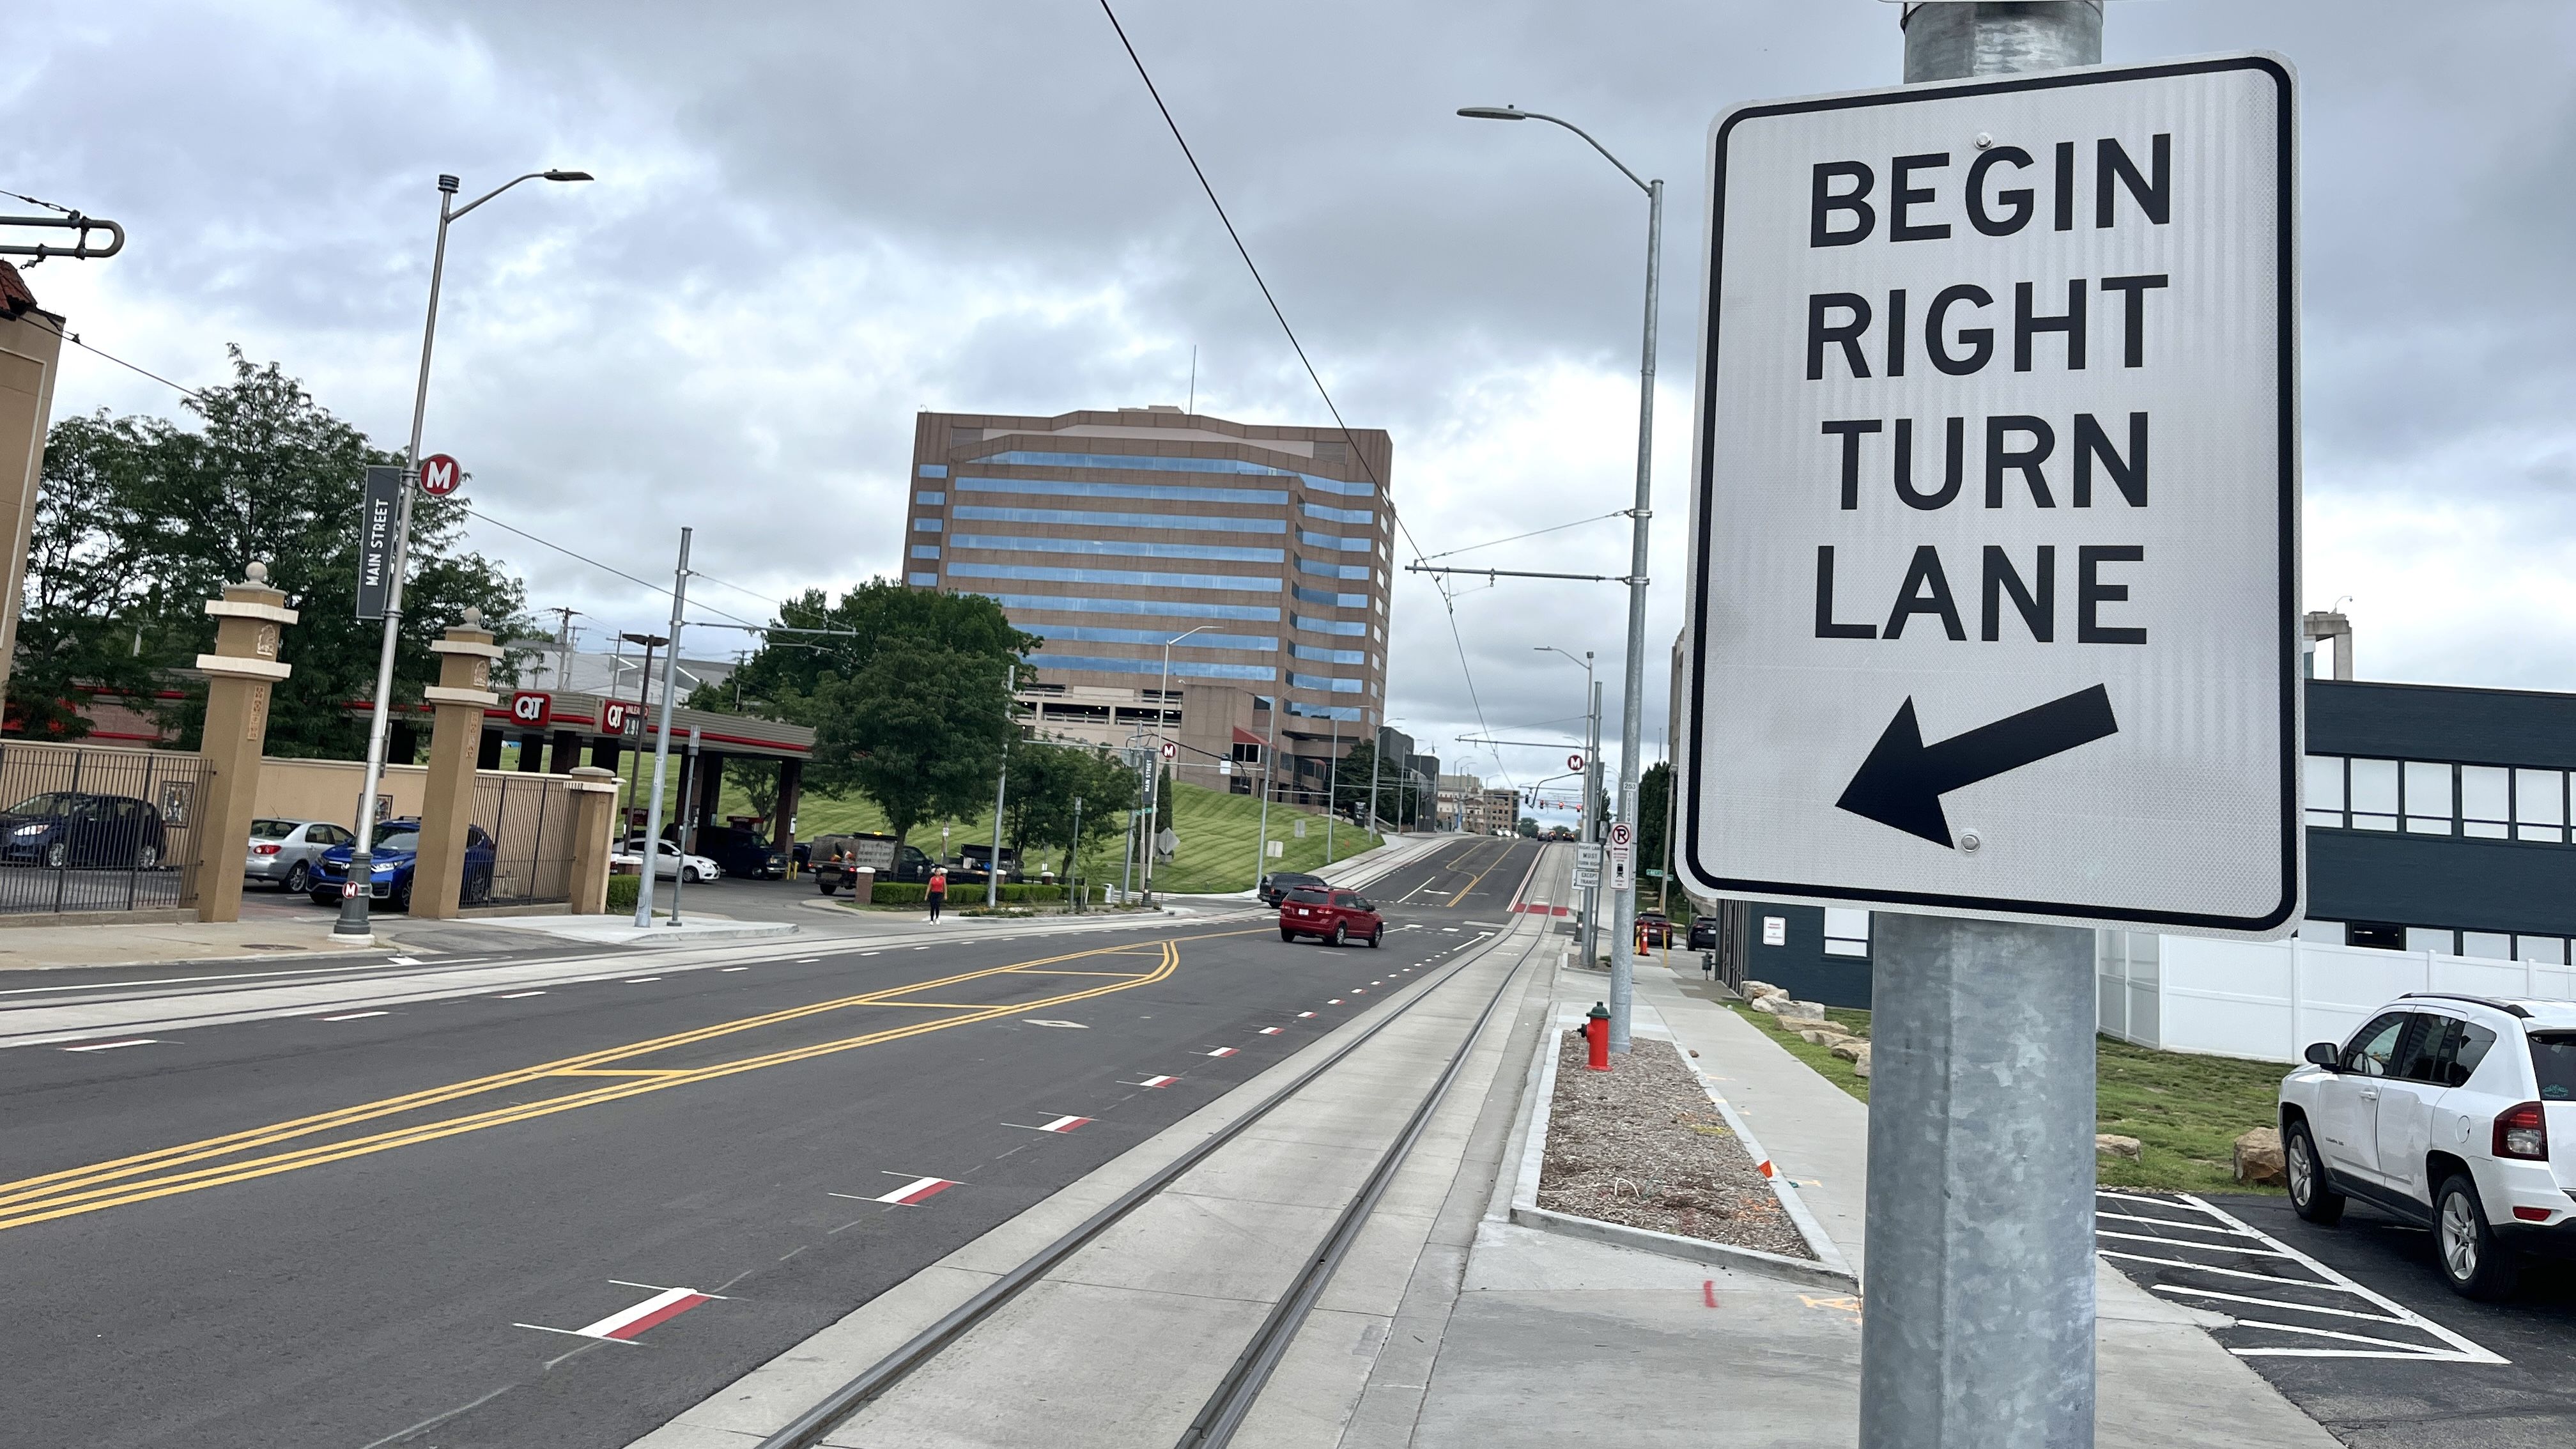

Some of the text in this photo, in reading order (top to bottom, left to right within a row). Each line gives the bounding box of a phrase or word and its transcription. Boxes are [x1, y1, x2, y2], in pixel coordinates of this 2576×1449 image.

[1810, 134, 2171, 248] BEGIN
[1807, 274, 2168, 380] RIGHT
[1821, 412, 2148, 511] TURN
[427, 461, 452, 489] M
[365, 499, 389, 587] MAIN STREET
[1816, 546, 2147, 645] LANE
[515, 695, 544, 720] QT
[608, 704, 624, 729] QT
[626, 704, 649, 717] UNLEAD
[1164, 745, 1174, 757] M
[1570, 757, 1580, 768] M
[345, 883, 356, 897] M
